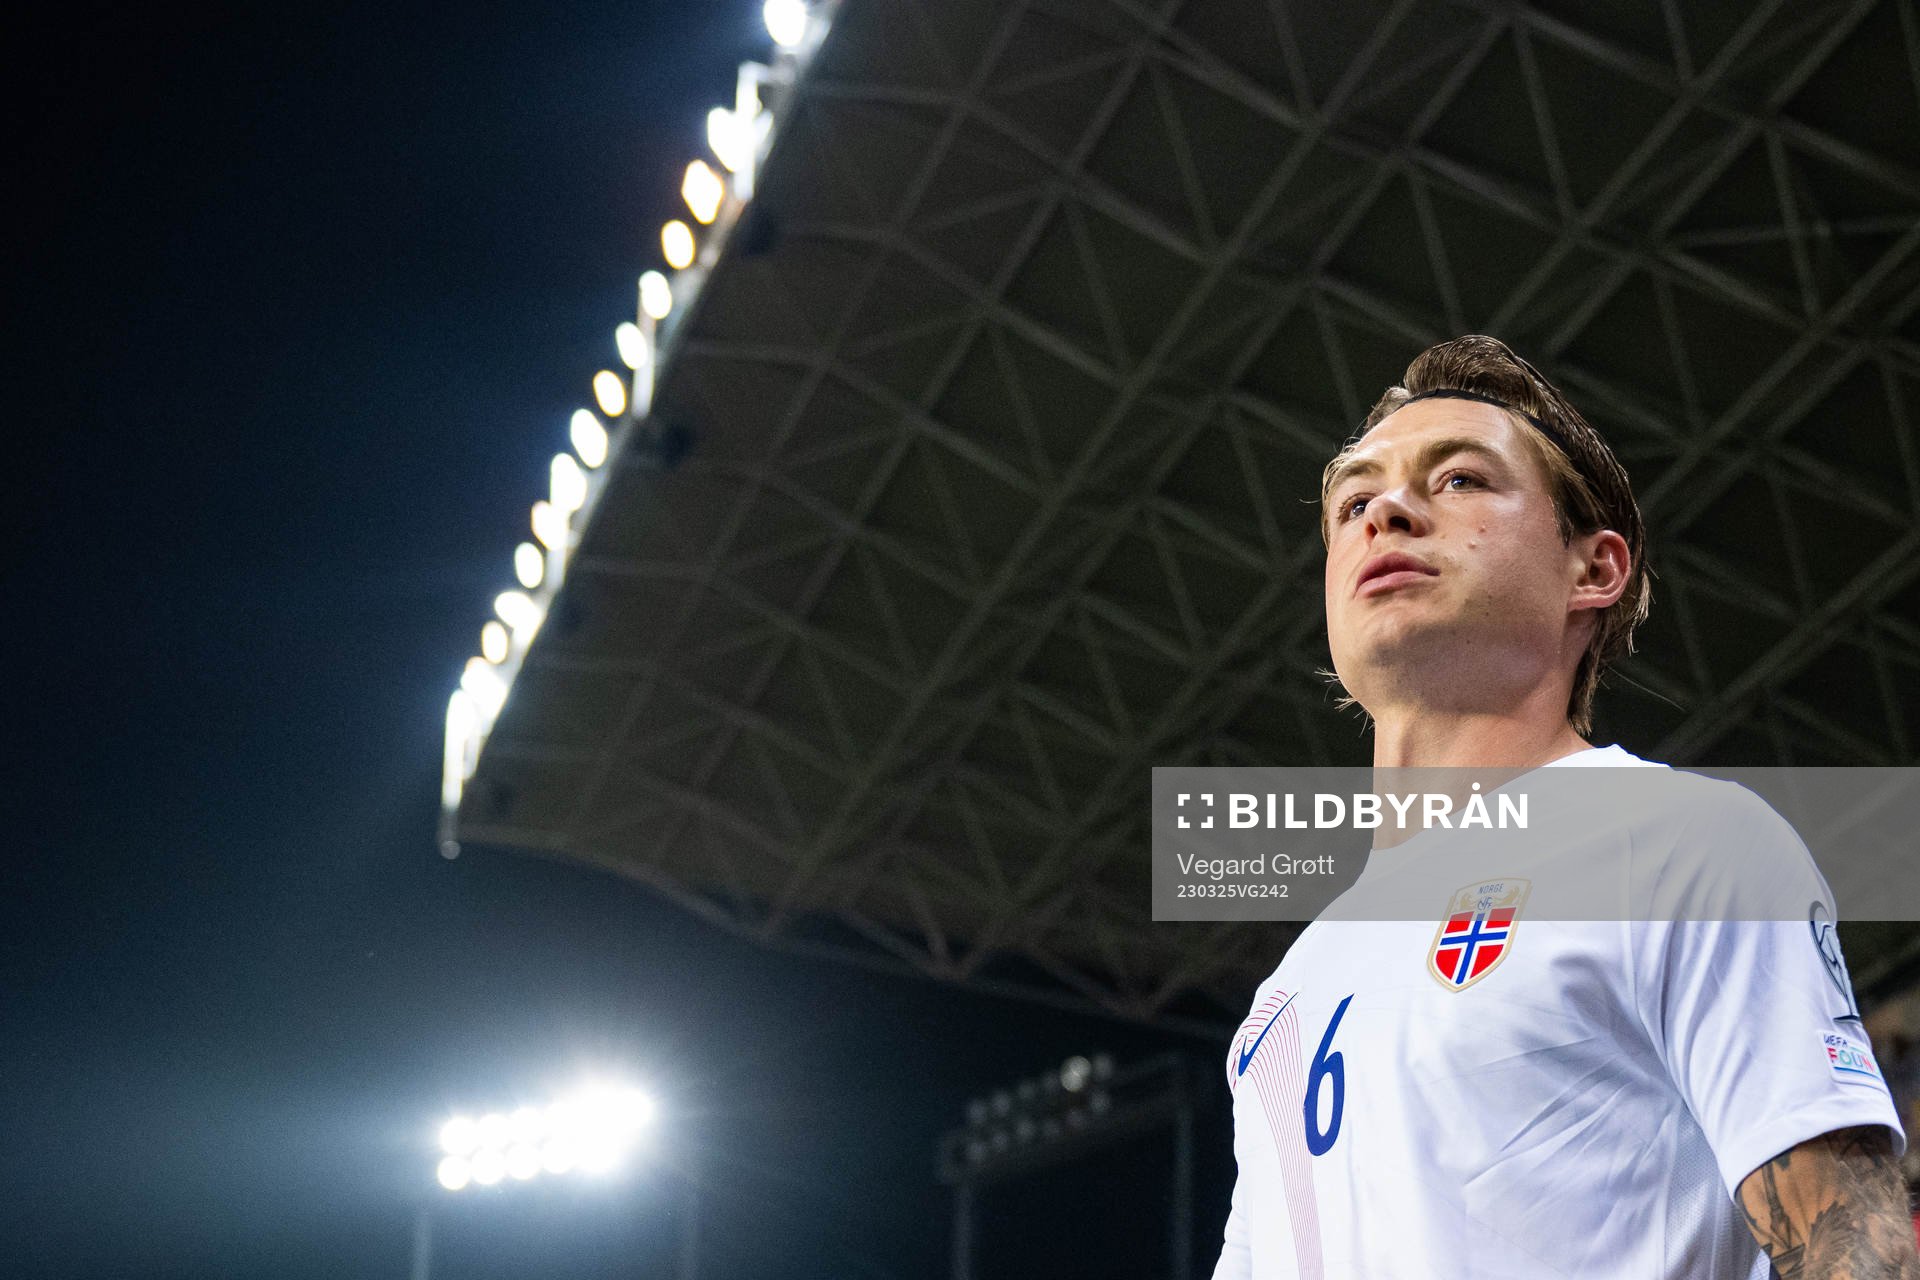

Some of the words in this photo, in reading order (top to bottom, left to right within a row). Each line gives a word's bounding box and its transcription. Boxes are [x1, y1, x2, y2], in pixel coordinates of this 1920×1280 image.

[1479, 884, 1504, 894] NORGE
[1823, 1034, 1849, 1048] UEFA
[1303, 993, 1355, 1157] 6
